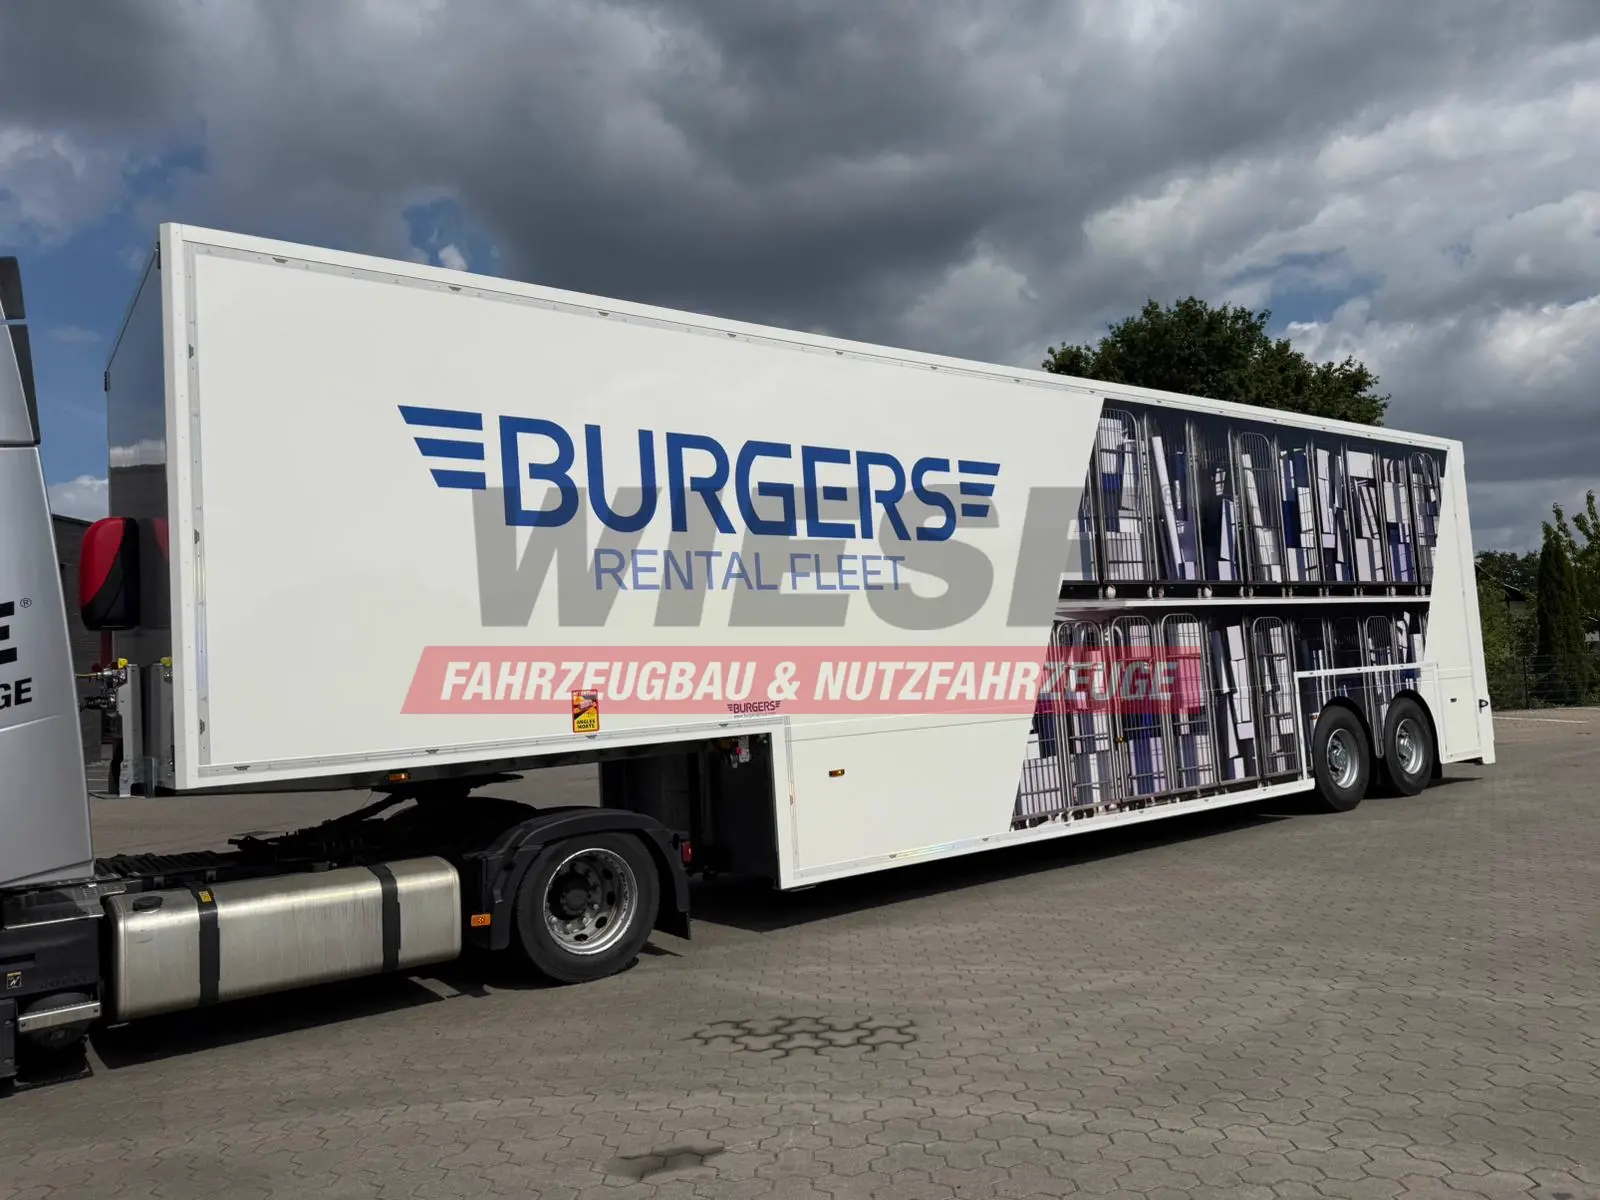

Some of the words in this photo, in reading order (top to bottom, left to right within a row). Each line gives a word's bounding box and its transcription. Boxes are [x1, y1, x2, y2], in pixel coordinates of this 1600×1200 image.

[498, 413, 958, 541] BURGERS
[594, 548, 779, 591] RENTAL
[789, 554, 906, 591] FLEET
[733, 700, 776, 714] BURGERS
